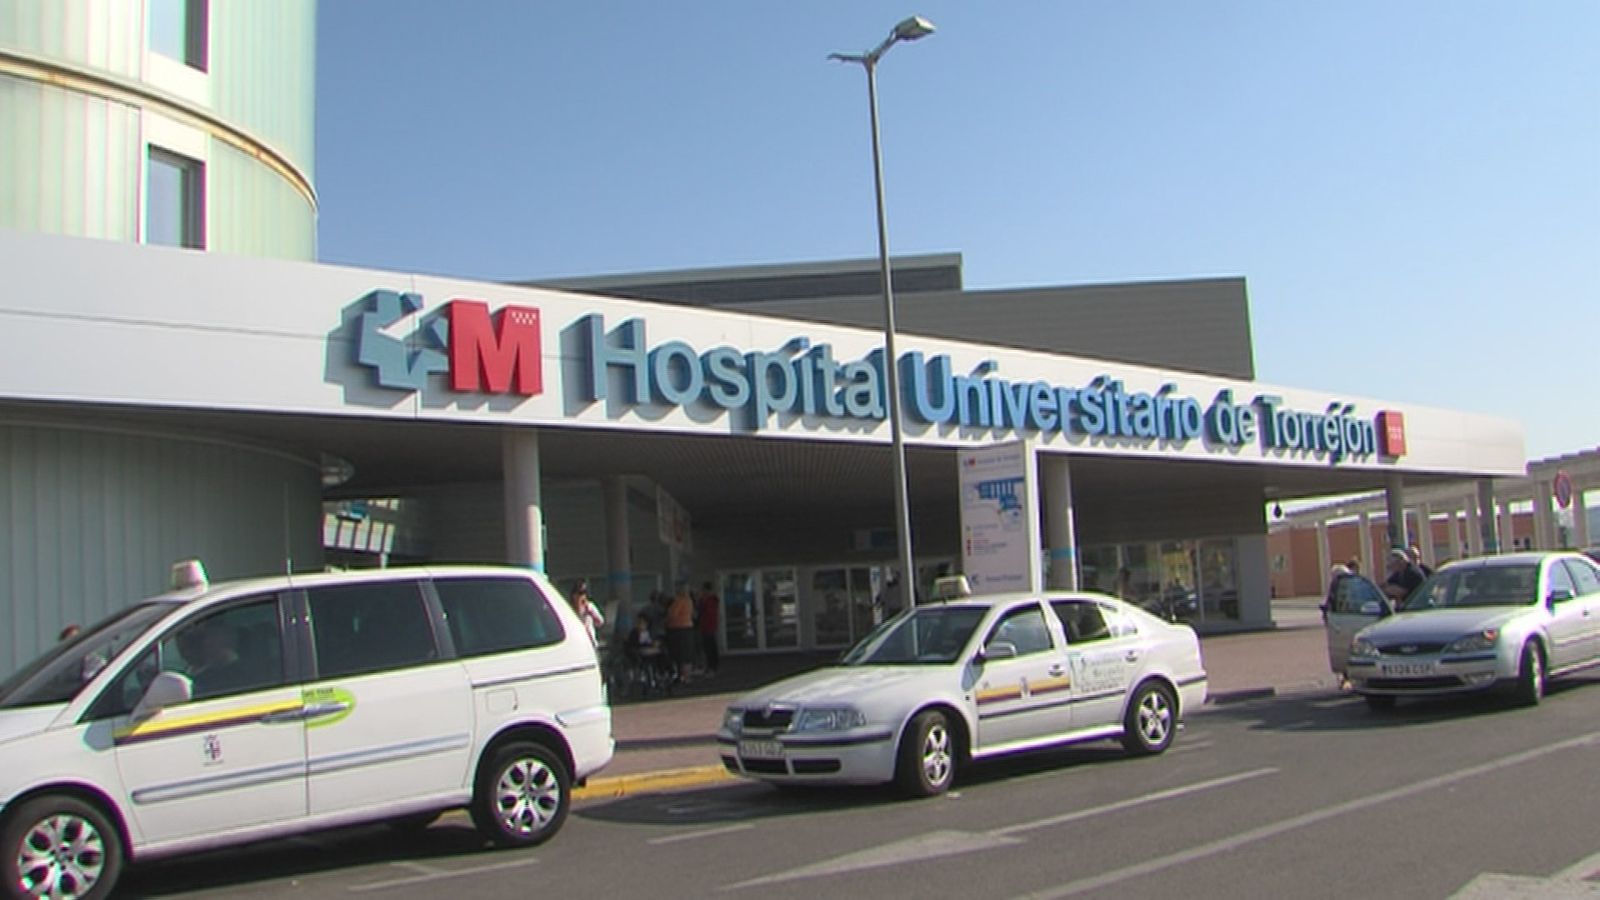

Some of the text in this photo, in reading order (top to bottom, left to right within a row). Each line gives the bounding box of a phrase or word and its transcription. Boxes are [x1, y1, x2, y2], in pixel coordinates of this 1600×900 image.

[448, 300, 542, 395] M
[910, 350, 1202, 440] Universitario
[1214, 388, 1256, 444] de
[1260, 394, 1377, 461] Torrejón
